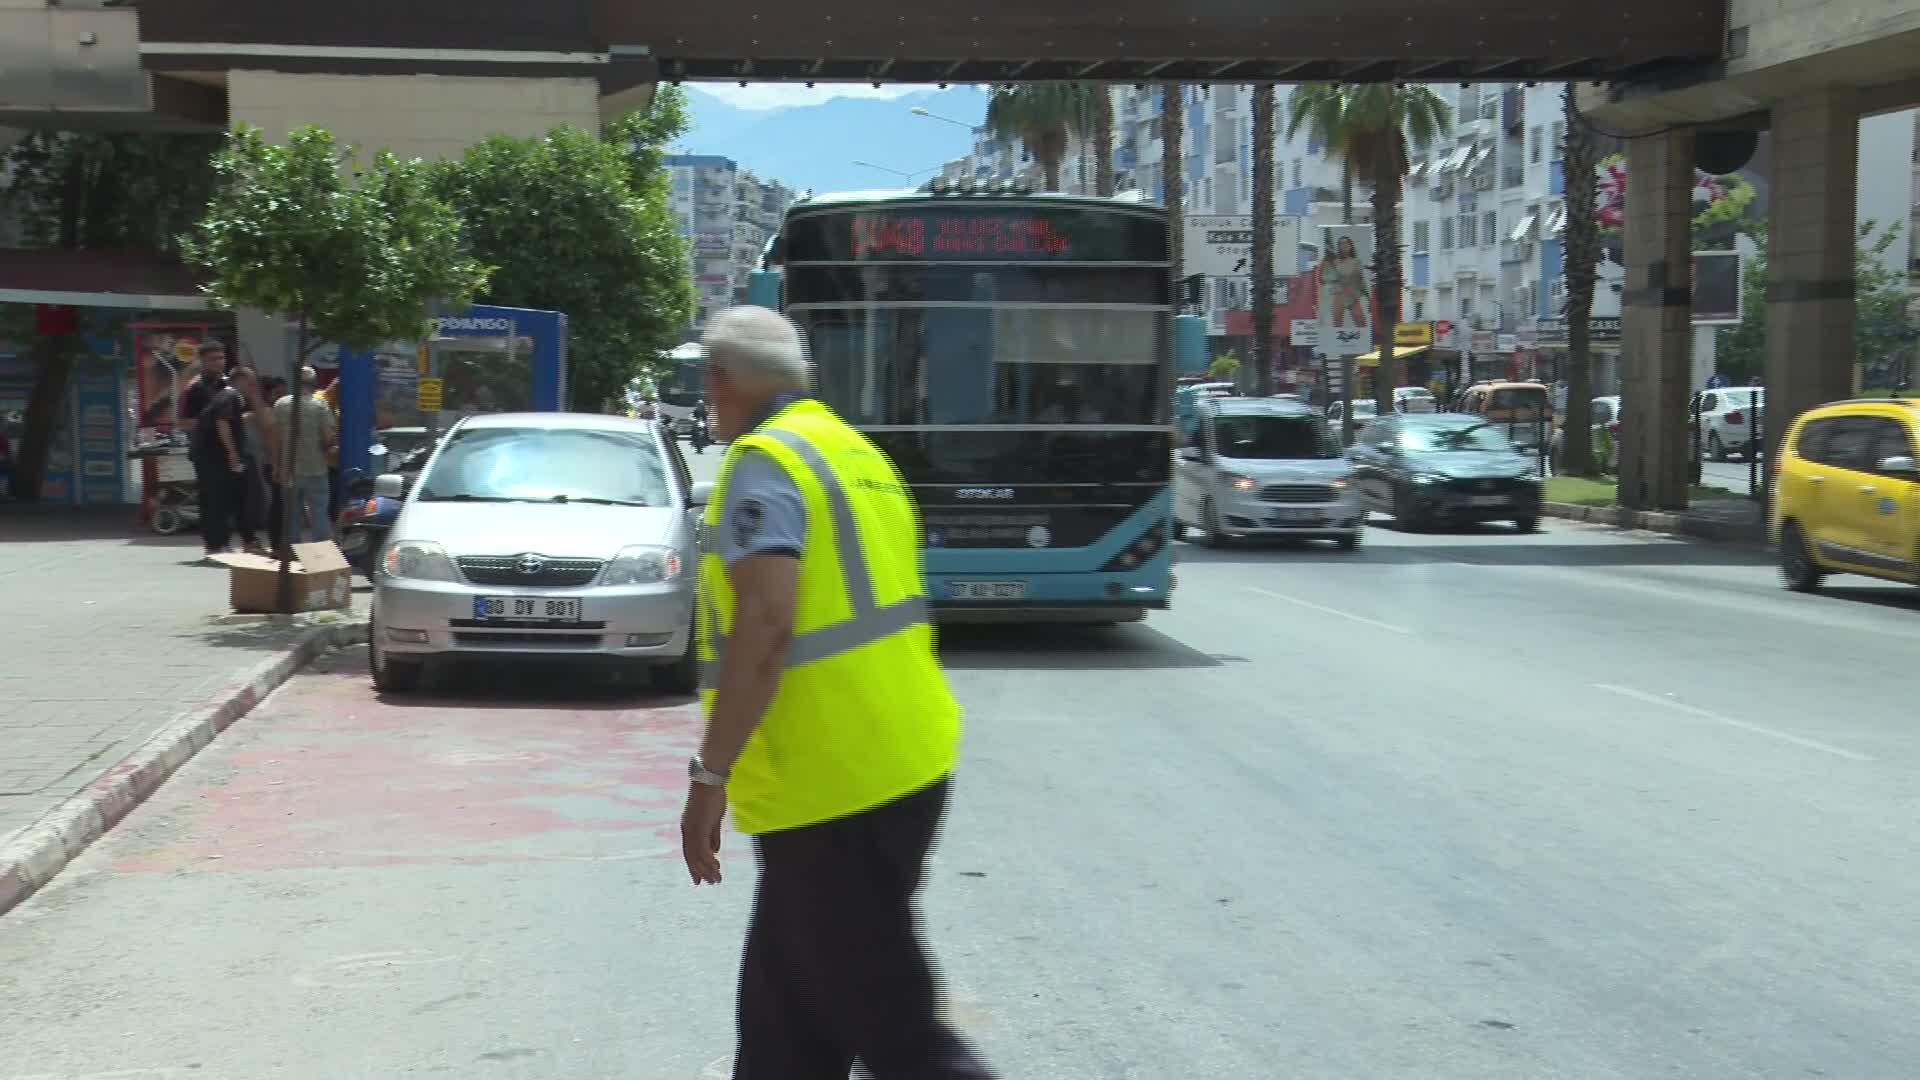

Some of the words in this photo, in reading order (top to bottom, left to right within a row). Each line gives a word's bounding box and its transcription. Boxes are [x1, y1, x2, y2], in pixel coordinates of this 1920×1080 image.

[955, 488, 1015, 499] OTOKAR
[514, 600, 535, 615] DV
[545, 601, 575, 616] 801
